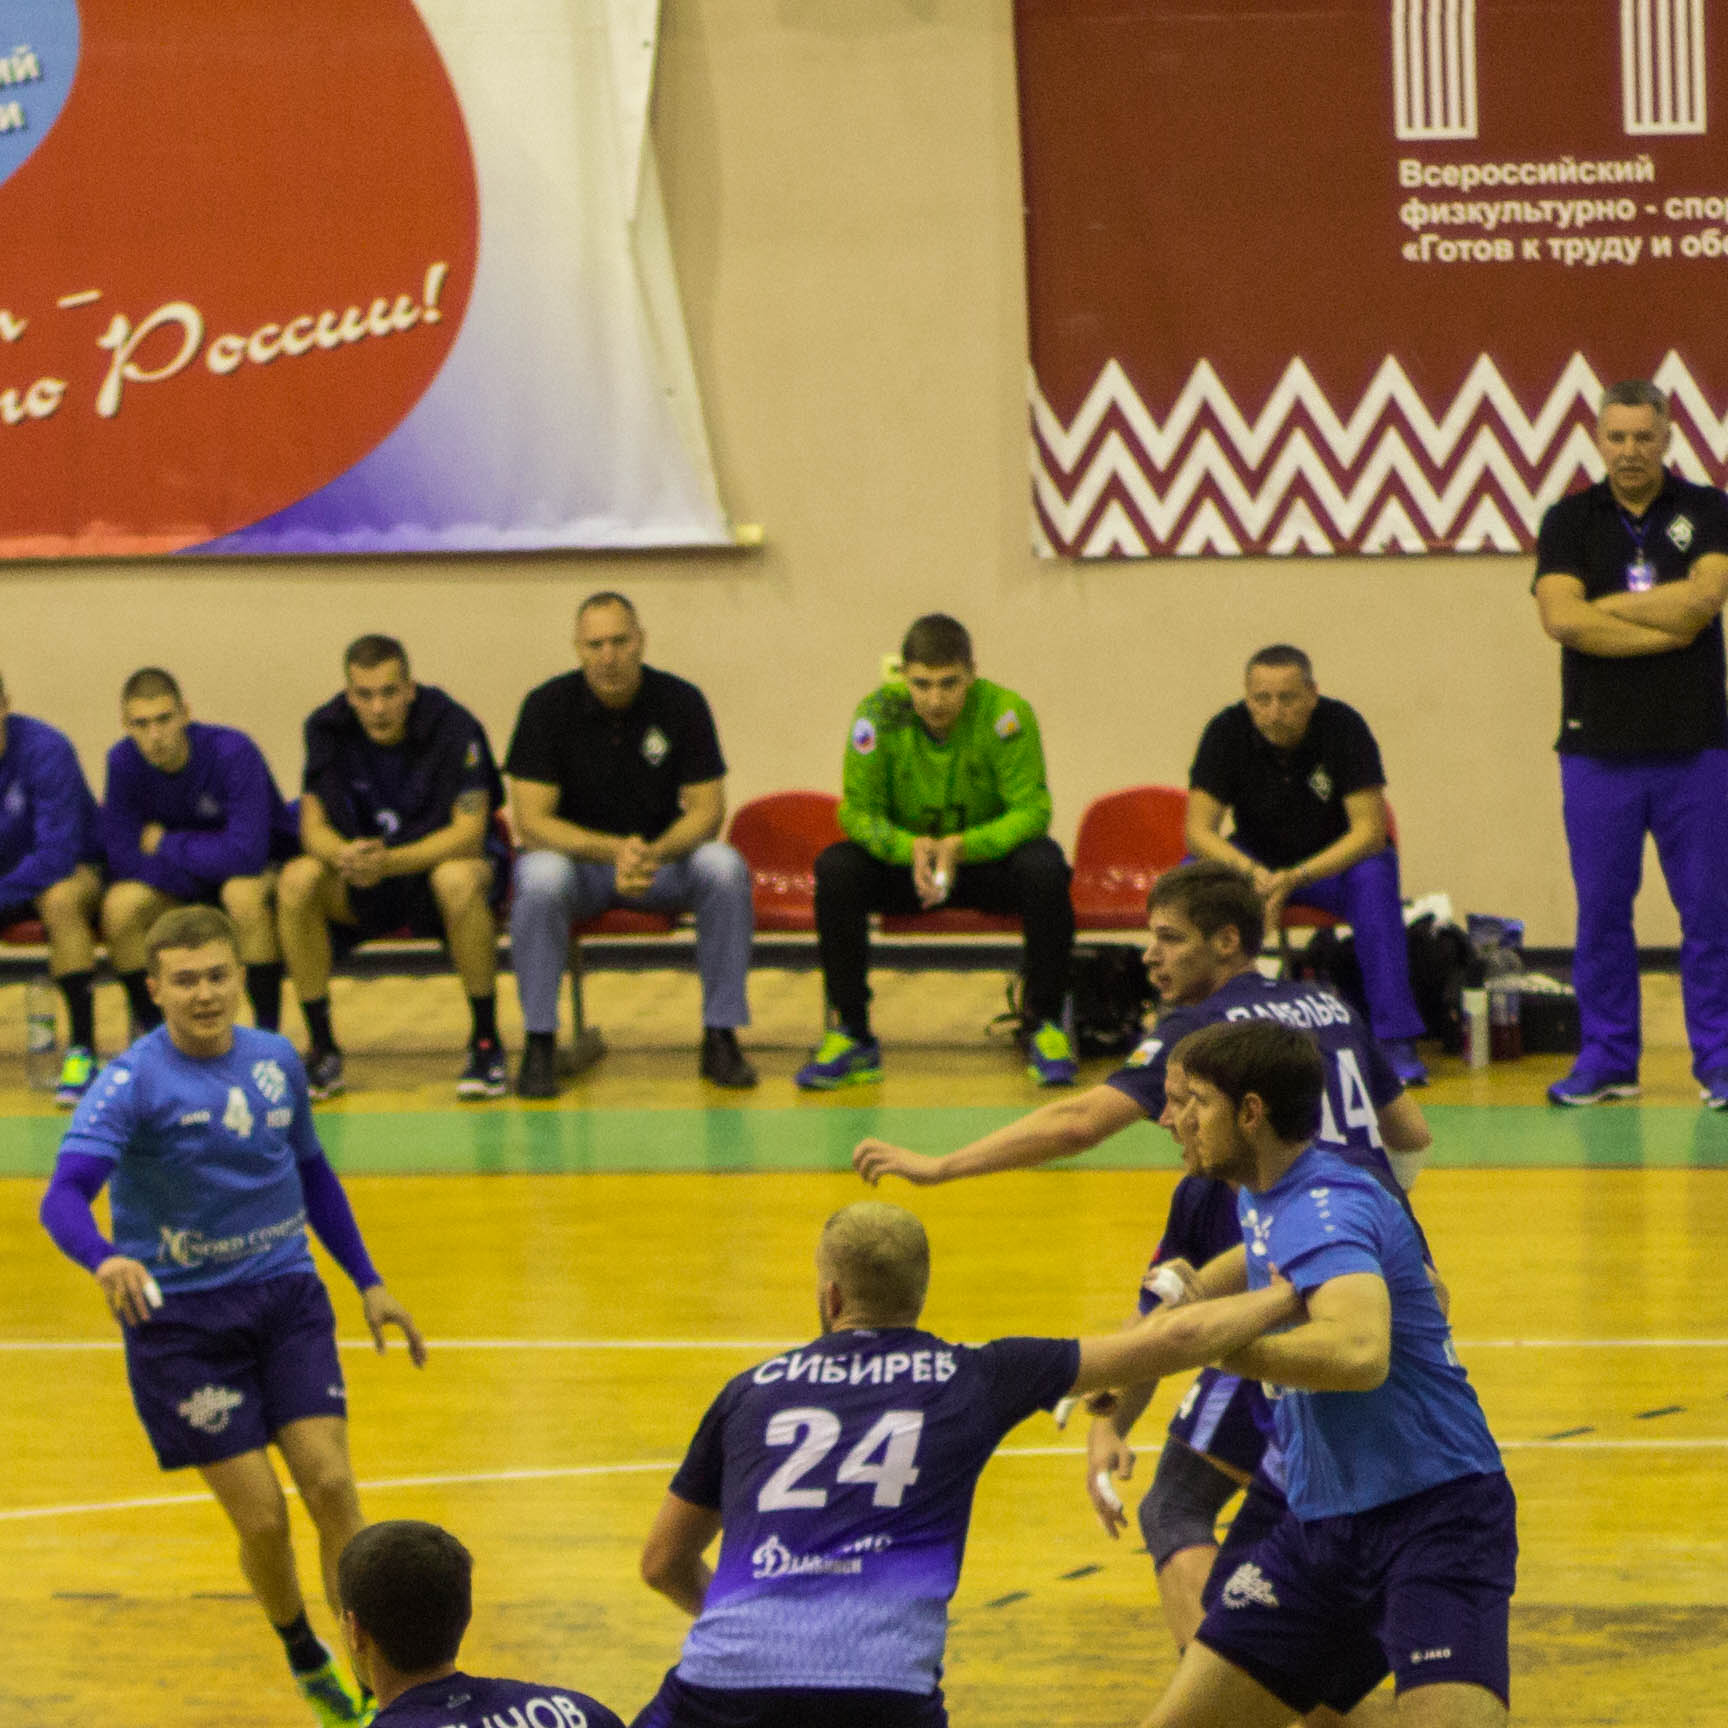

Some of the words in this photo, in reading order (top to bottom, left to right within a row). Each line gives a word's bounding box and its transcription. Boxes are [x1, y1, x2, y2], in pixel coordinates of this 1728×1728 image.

[1399, 154, 1656, 193] Всероссийский
[1399, 197, 1638, 232] физкультурно
[1522, 236, 1542, 261] к
[1547, 234, 1643, 267] труду
[1650, 236, 1673, 259] и
[95, 261, 448, 418] России!
[222, 1085, 254, 1138] 4
[756, 1405, 924, 1514] 24
